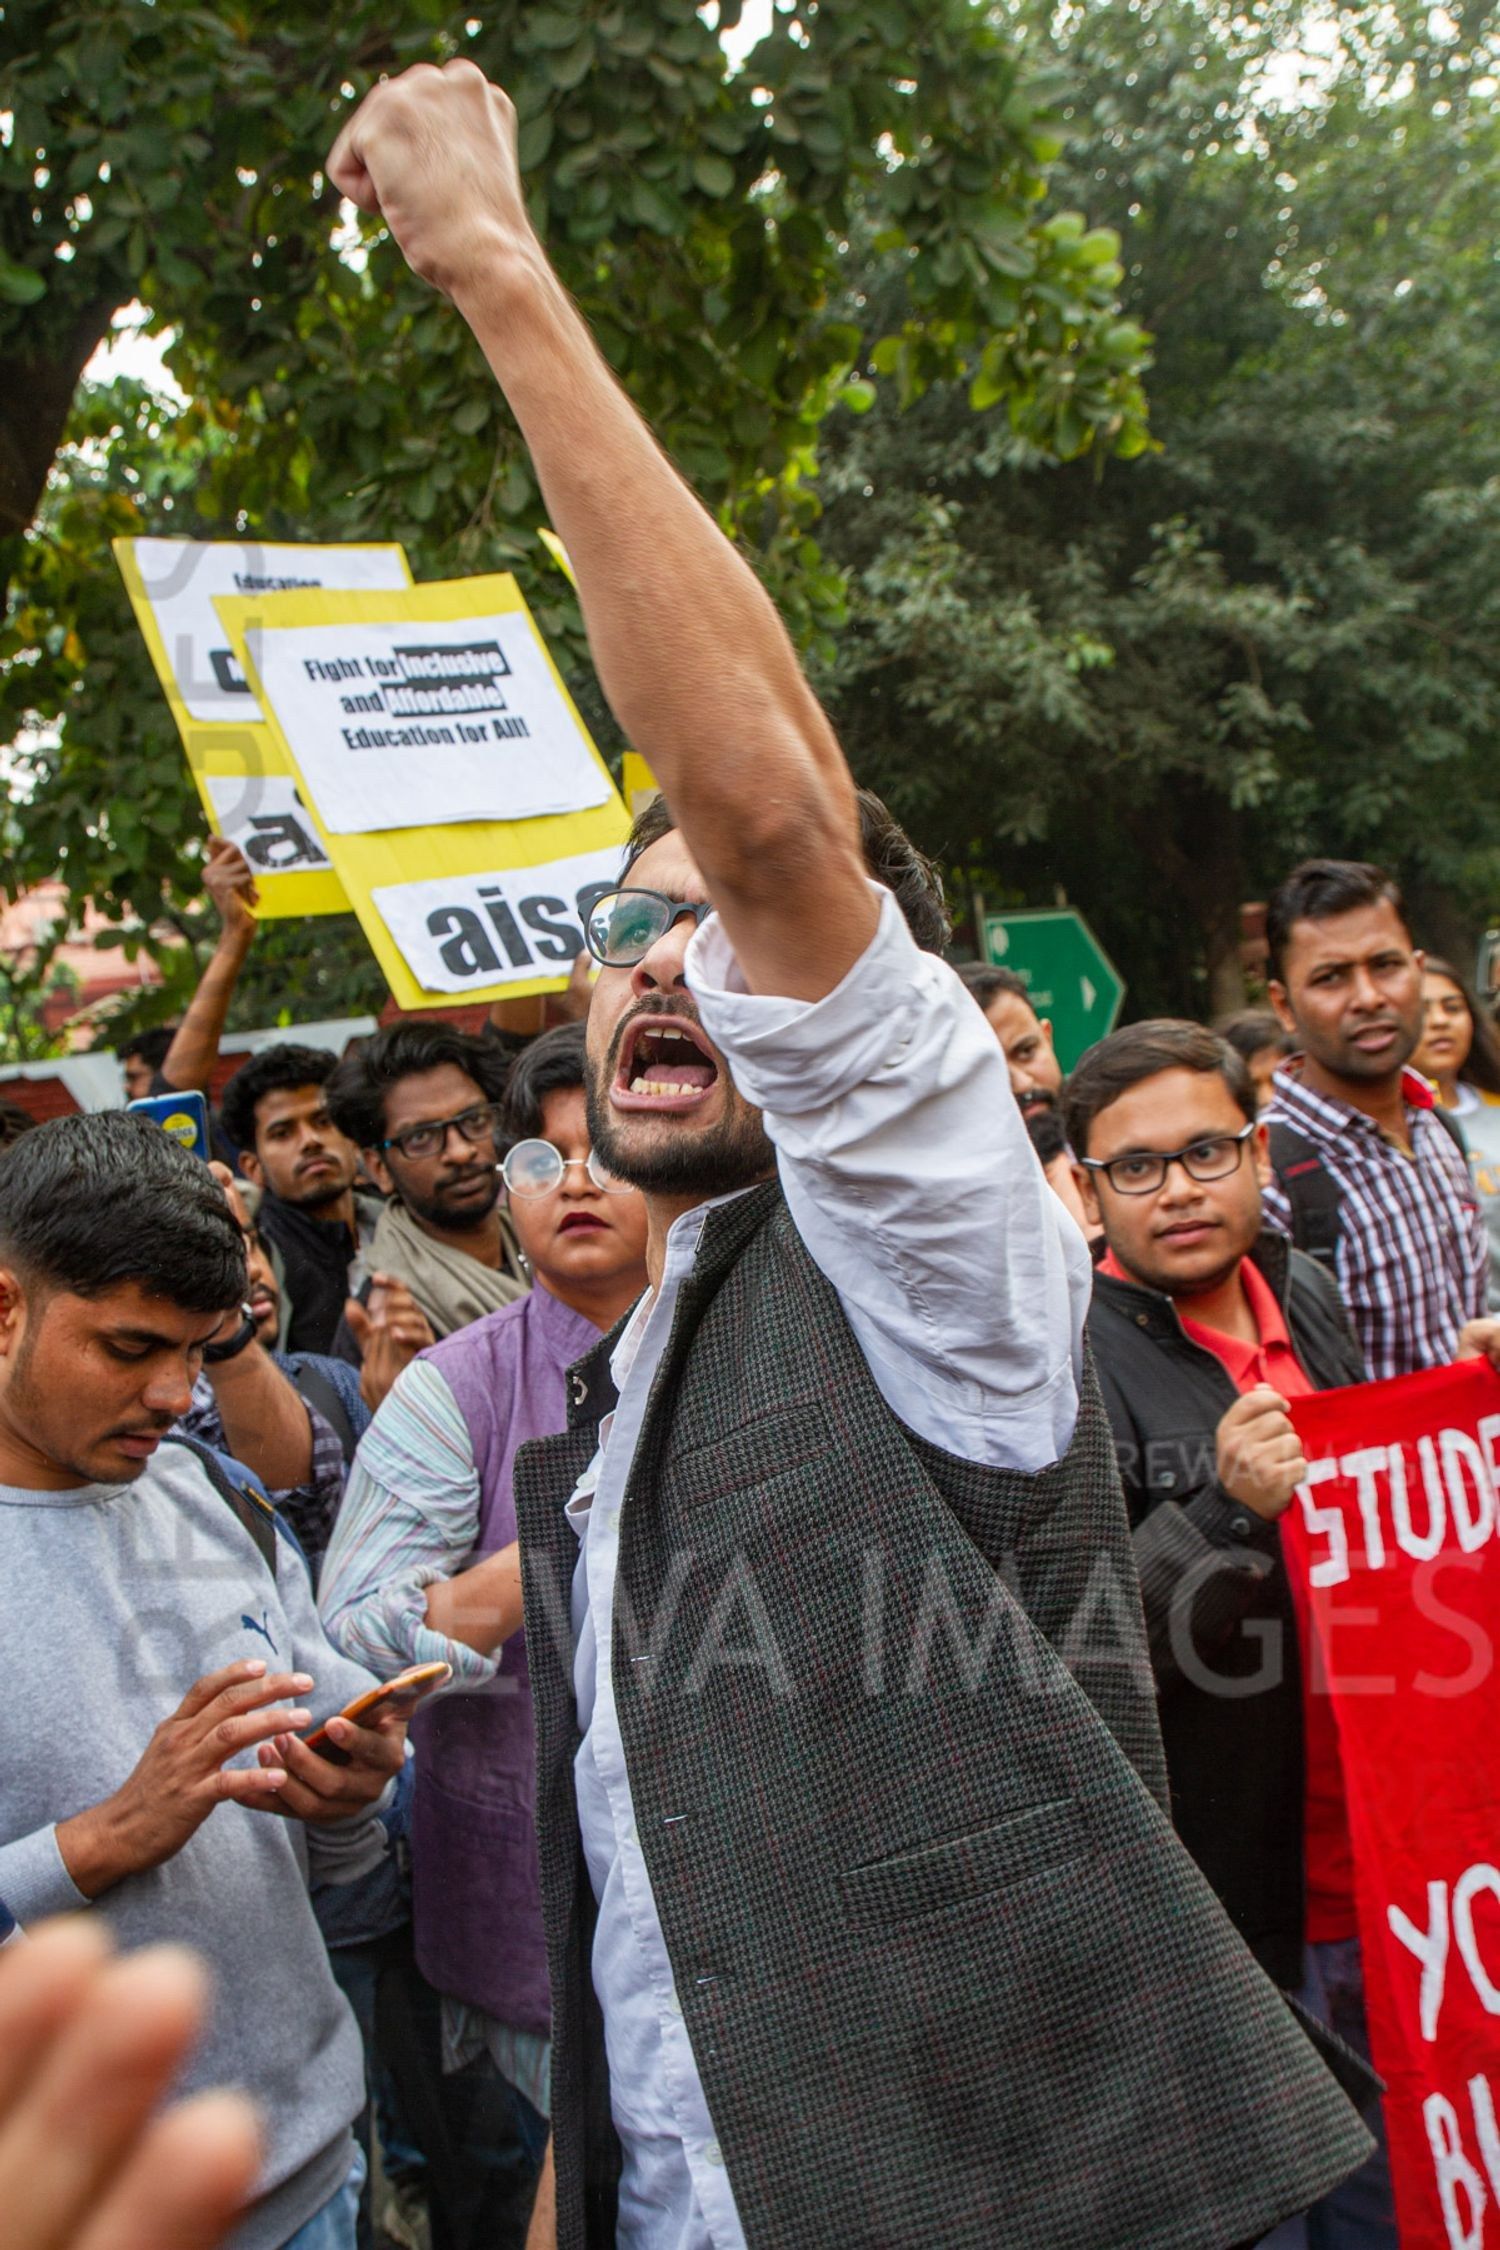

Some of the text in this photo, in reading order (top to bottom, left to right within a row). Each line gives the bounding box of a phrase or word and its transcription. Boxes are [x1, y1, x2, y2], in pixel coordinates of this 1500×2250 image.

[303, 650, 508, 682] Fight for Inclusive
[340, 684, 504, 715] and Affordable
[341, 717, 531, 750] Education for All!
